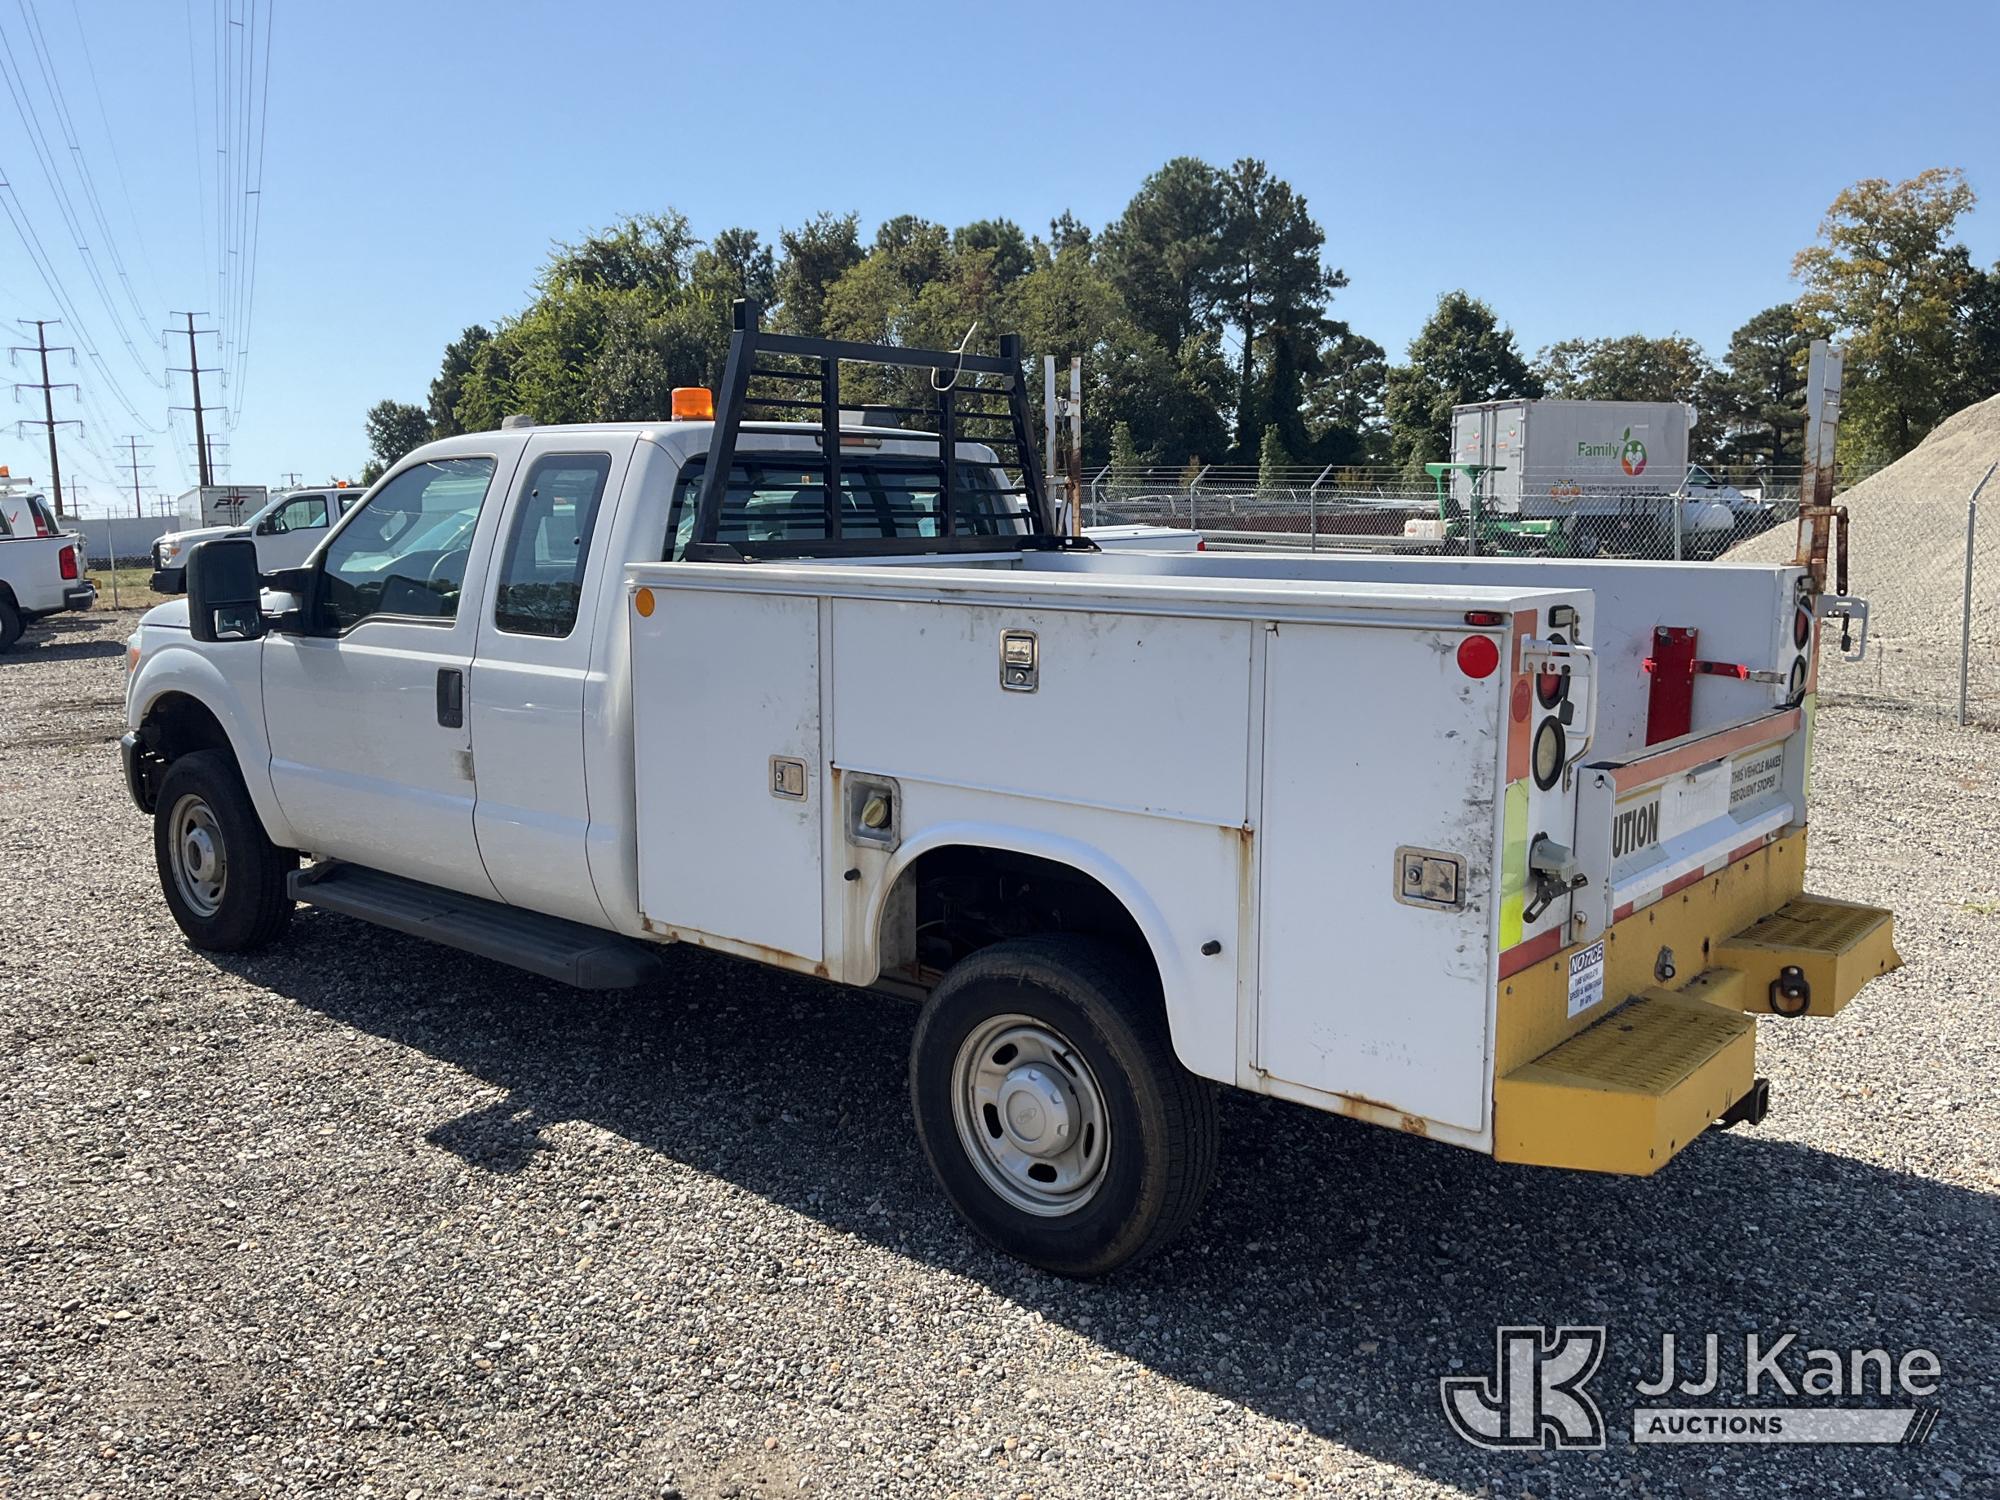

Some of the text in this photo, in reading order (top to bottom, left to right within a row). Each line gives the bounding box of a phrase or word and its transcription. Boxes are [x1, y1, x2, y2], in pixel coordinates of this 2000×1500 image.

[1578, 441, 1620, 459] Family
[1731, 754, 1782, 784] THIS VEHICLE MAKES
[1730, 782, 1757, 804] FREQUENT
[1612, 800, 1660, 859] UTION
[1571, 943, 1603, 973] NOTICE
